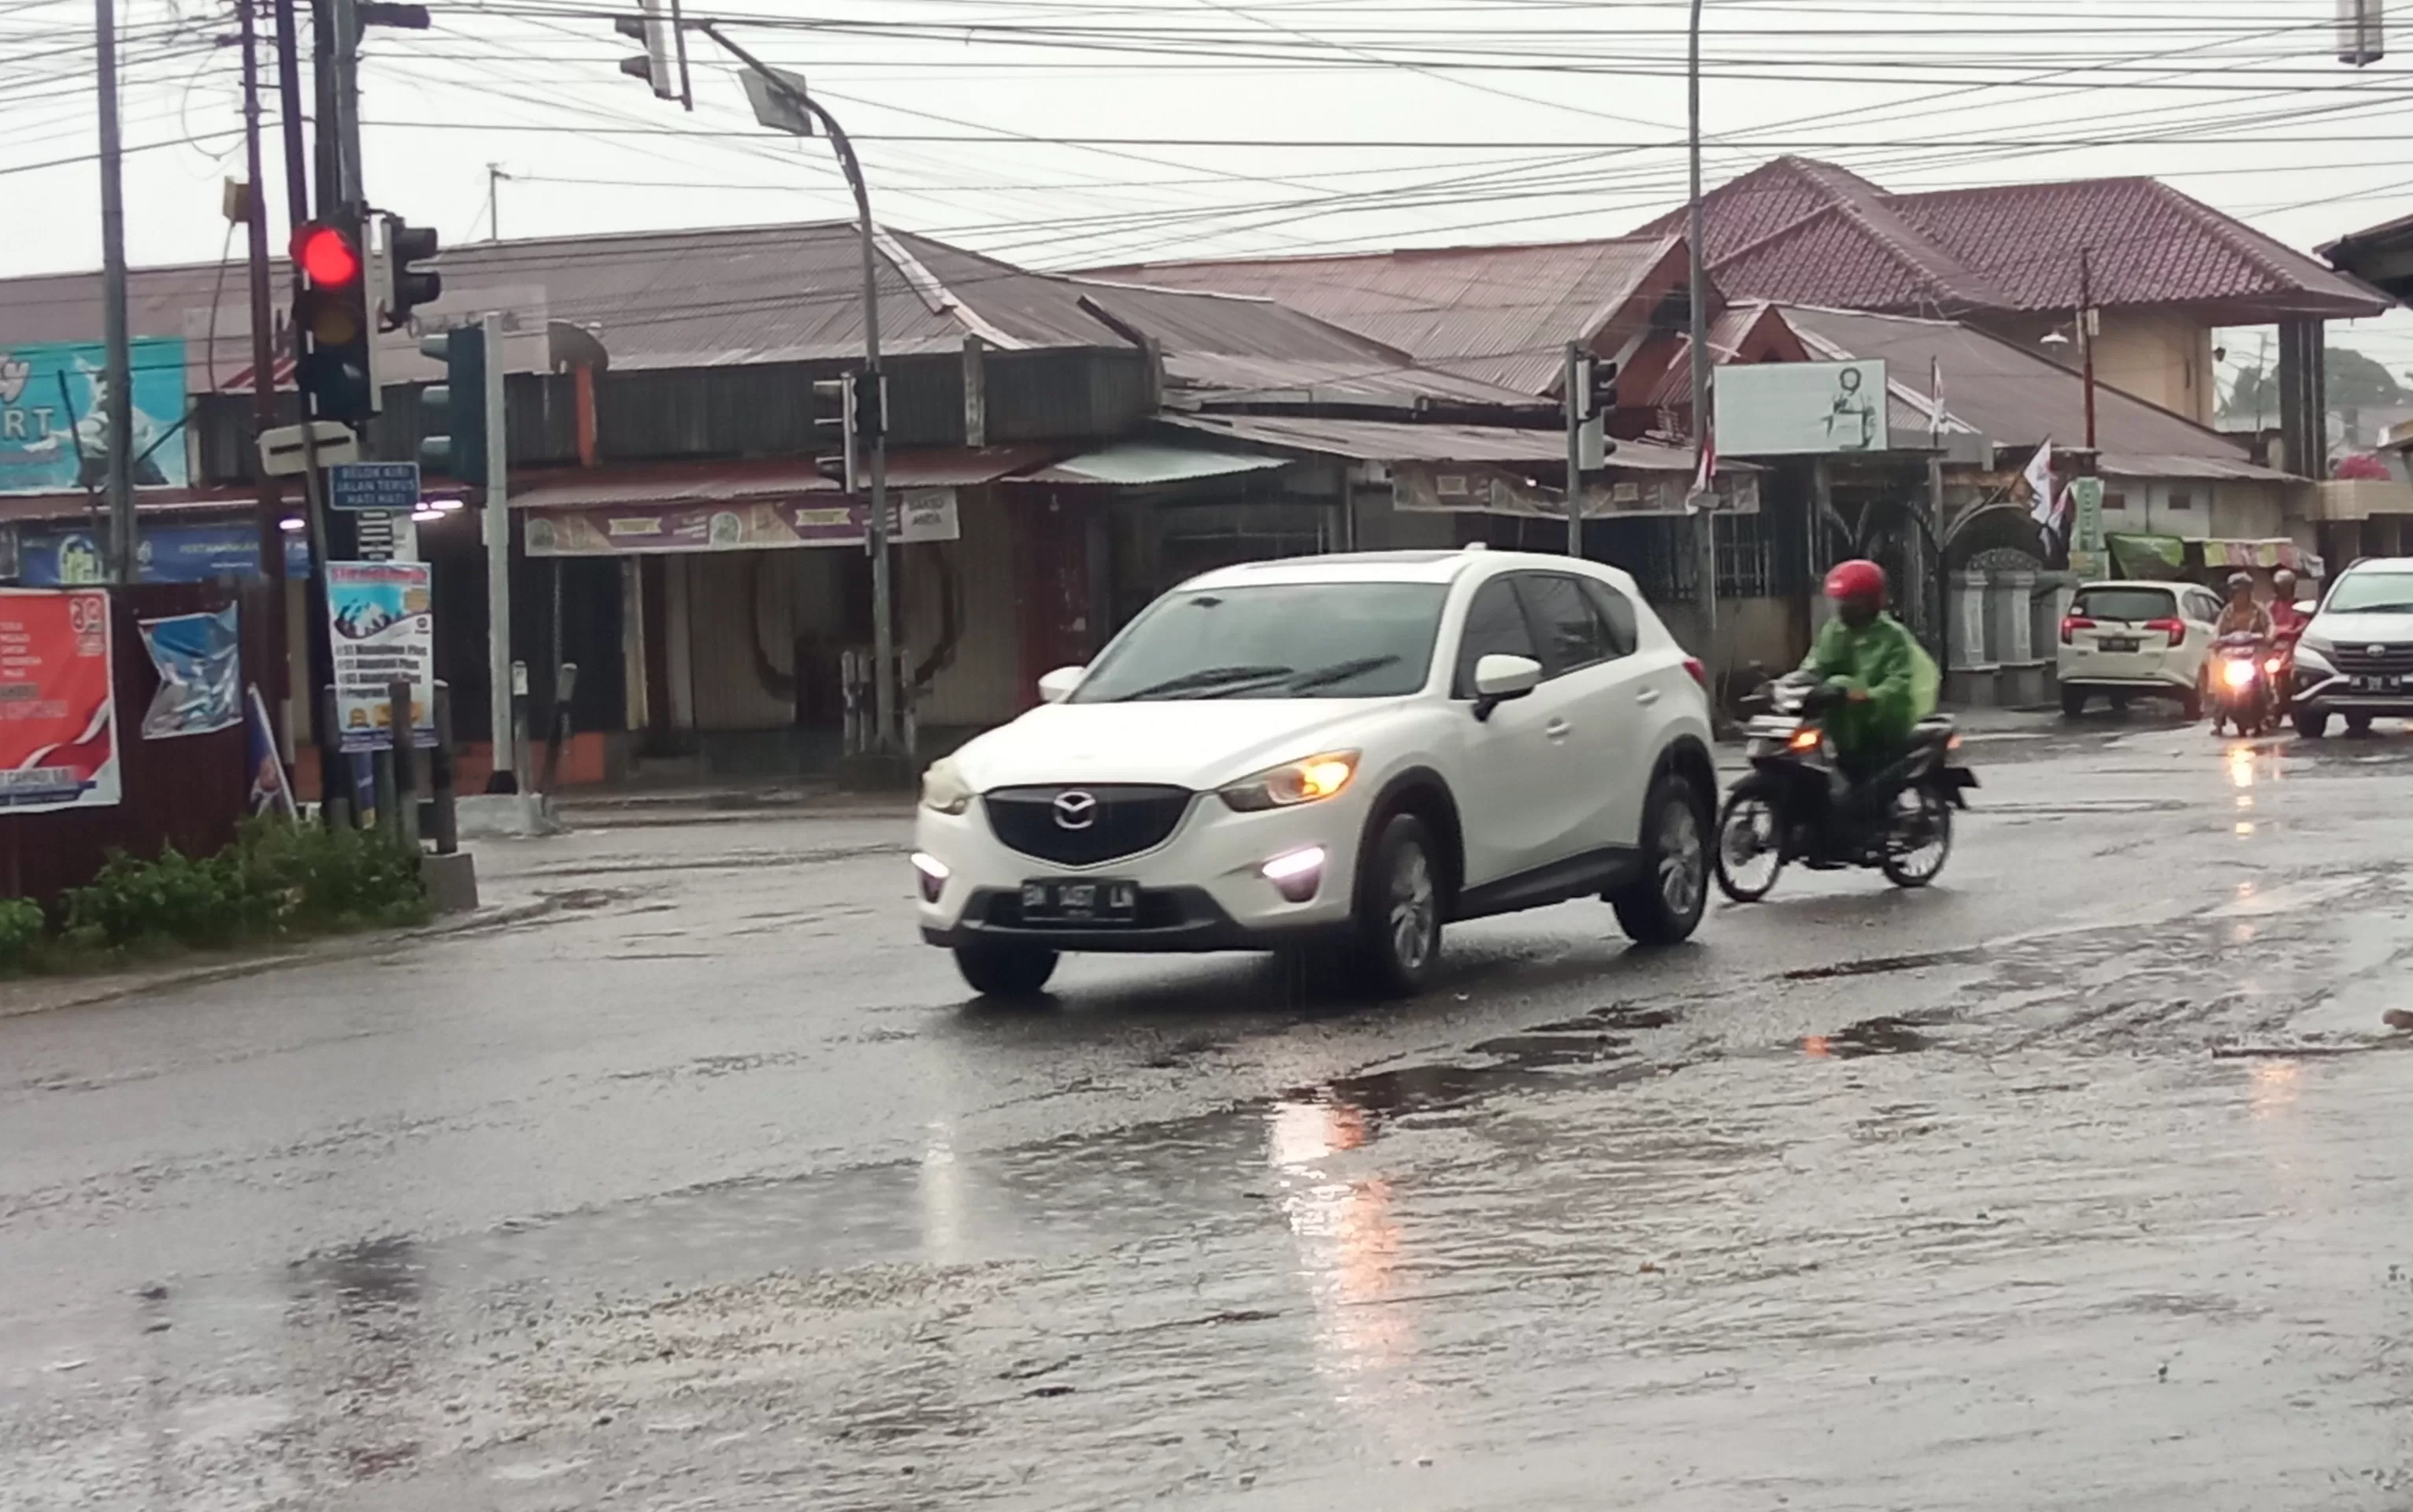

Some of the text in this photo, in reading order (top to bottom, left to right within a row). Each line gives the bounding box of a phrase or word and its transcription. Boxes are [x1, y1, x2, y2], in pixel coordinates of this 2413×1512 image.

[343, 466, 410, 479] BELOK KIRI
[336, 479, 415, 491] JALAN TERUS
[347, 492, 406, 504] HATI HATI
